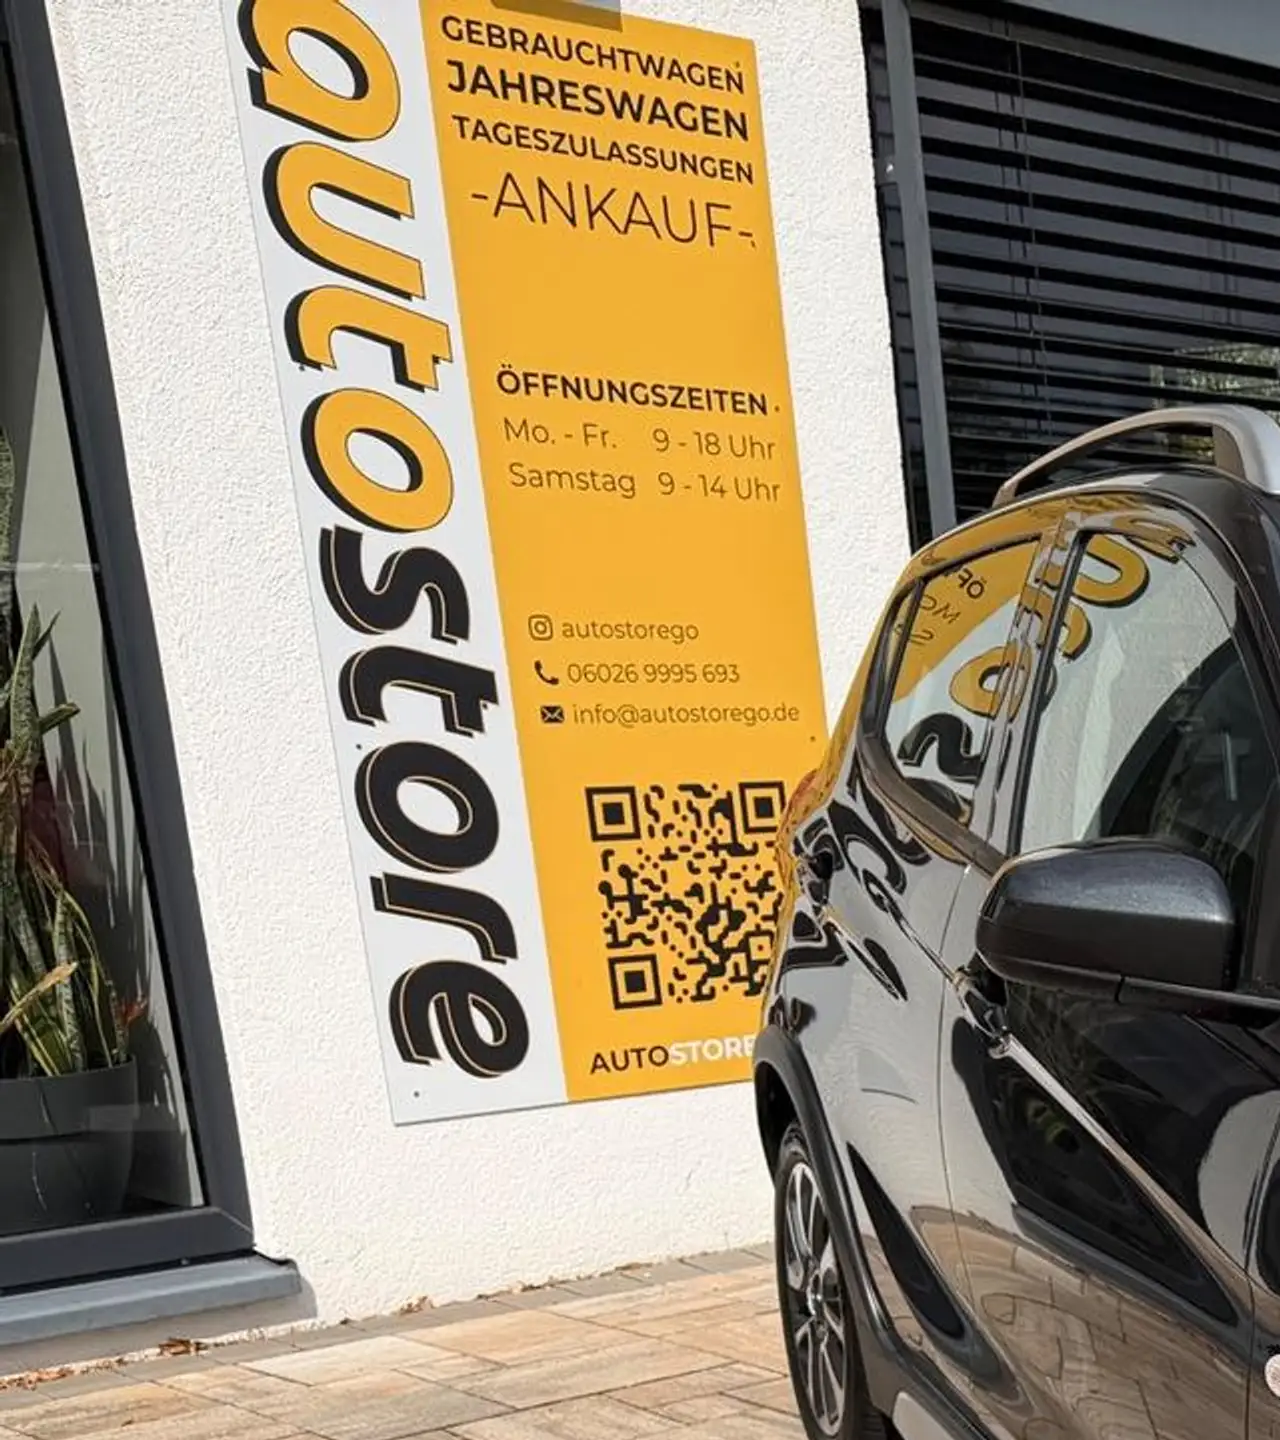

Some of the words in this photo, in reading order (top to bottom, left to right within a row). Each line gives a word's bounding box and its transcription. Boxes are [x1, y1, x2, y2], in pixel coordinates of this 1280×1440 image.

[441, 15, 744, 94] GEBRAUCHTWAGEN
[447, 60, 749, 141] JAHRESWAGEN
[452, 115, 753, 184] TAGESZULASSUNGEN
[471, 172, 753, 247] -ANKAUF-
[496, 364, 767, 416] ÖFFNUNGSZEITEN
[503, 417, 555, 445] Mo.
[582, 423, 617, 449] Fr.
[652, 428, 670, 452] 9
[694, 432, 721, 456] 18
[729, 435, 775, 459] Uhr
[509, 463, 636, 499] Samstag
[658, 472, 675, 496] 9
[699, 474, 726, 498] 14
[734, 478, 780, 501] Uhr
[238, 0, 530, 1079] autostore
[561, 622, 700, 644] autostorego
[567, 663, 639, 683] 06026
[643, 663, 697, 684] 9995
[702, 663, 740, 683] 693
[573, 703, 800, 728] info@autostorego.de
